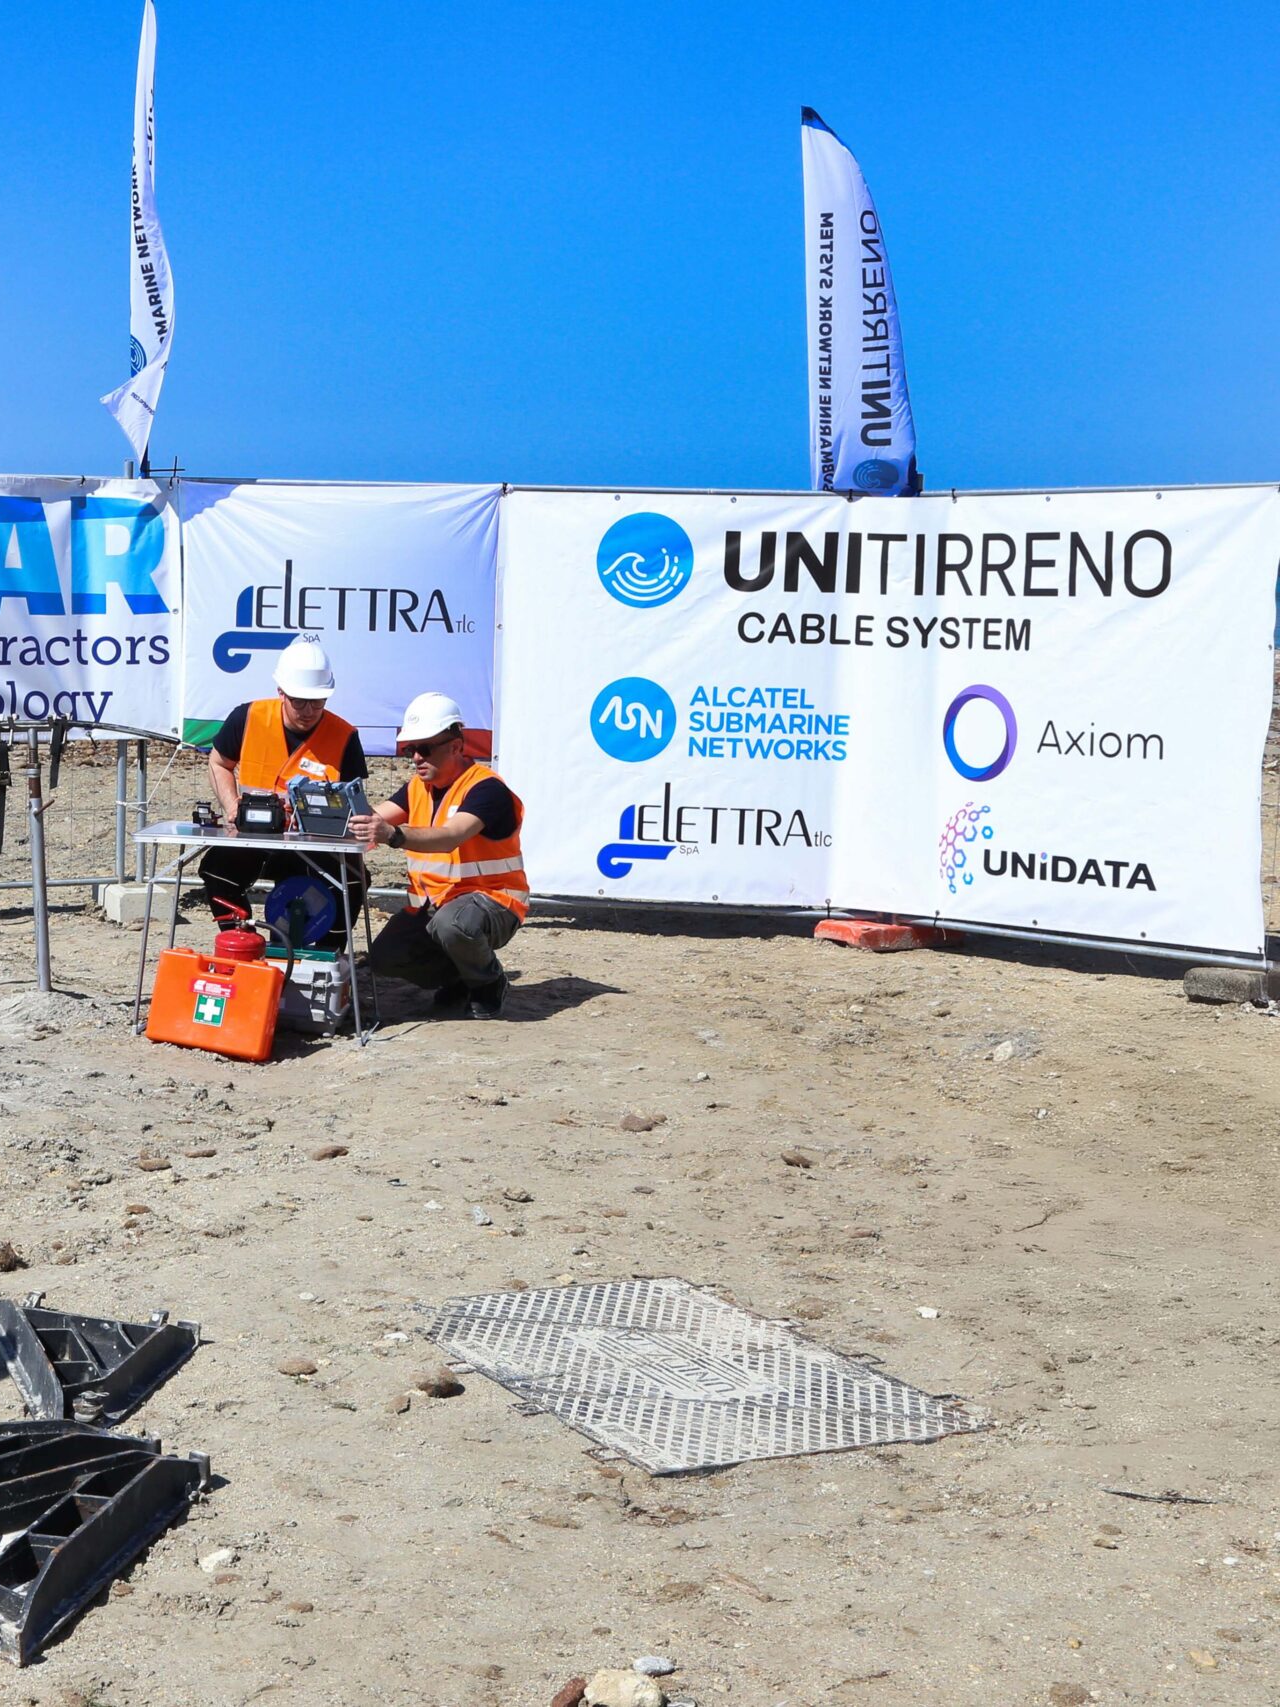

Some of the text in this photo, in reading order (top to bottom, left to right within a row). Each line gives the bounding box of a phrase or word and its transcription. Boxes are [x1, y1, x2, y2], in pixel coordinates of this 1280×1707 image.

[723, 529, 1172, 598] UNITIRRENO
[737, 611, 1032, 651] CABLE SYSTEM
[689, 685, 815, 710] ALCATEL
[688, 711, 850, 736] SUBMARINE
[687, 736, 847, 761] NETWORKS
[1036, 720, 1164, 760] Axiom
[679, 844, 700, 856] SpA
